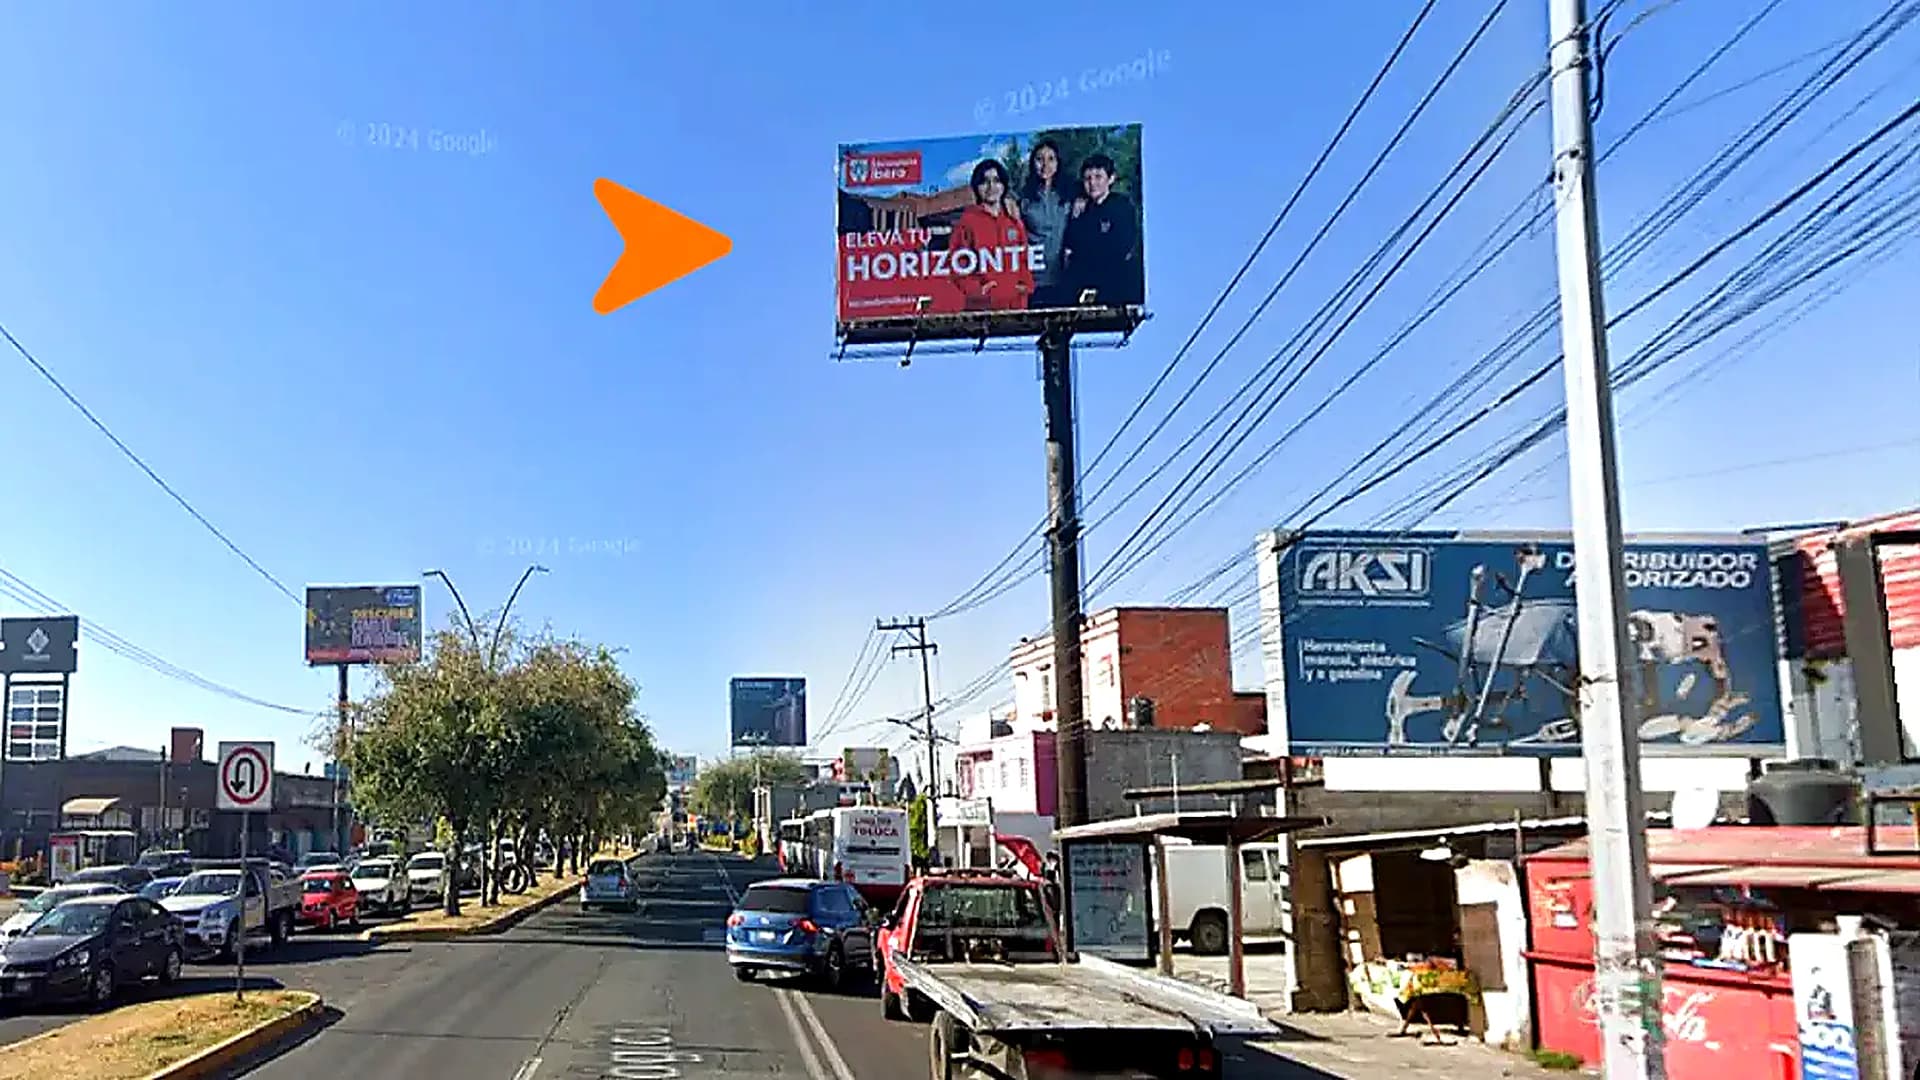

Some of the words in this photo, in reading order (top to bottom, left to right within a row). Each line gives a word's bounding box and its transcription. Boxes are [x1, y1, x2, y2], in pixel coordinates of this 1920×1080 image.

[845, 230, 903, 248] ELEVA
[907, 228, 932, 245] TU
[848, 244, 1046, 281] HORIZONTE
[1556, 551, 1757, 570] DRIBUIDOR
[1302, 552, 1424, 596] AKSI
[1565, 570, 1750, 588] AORIZADO
[853, 827, 899, 837] TOLUCA
